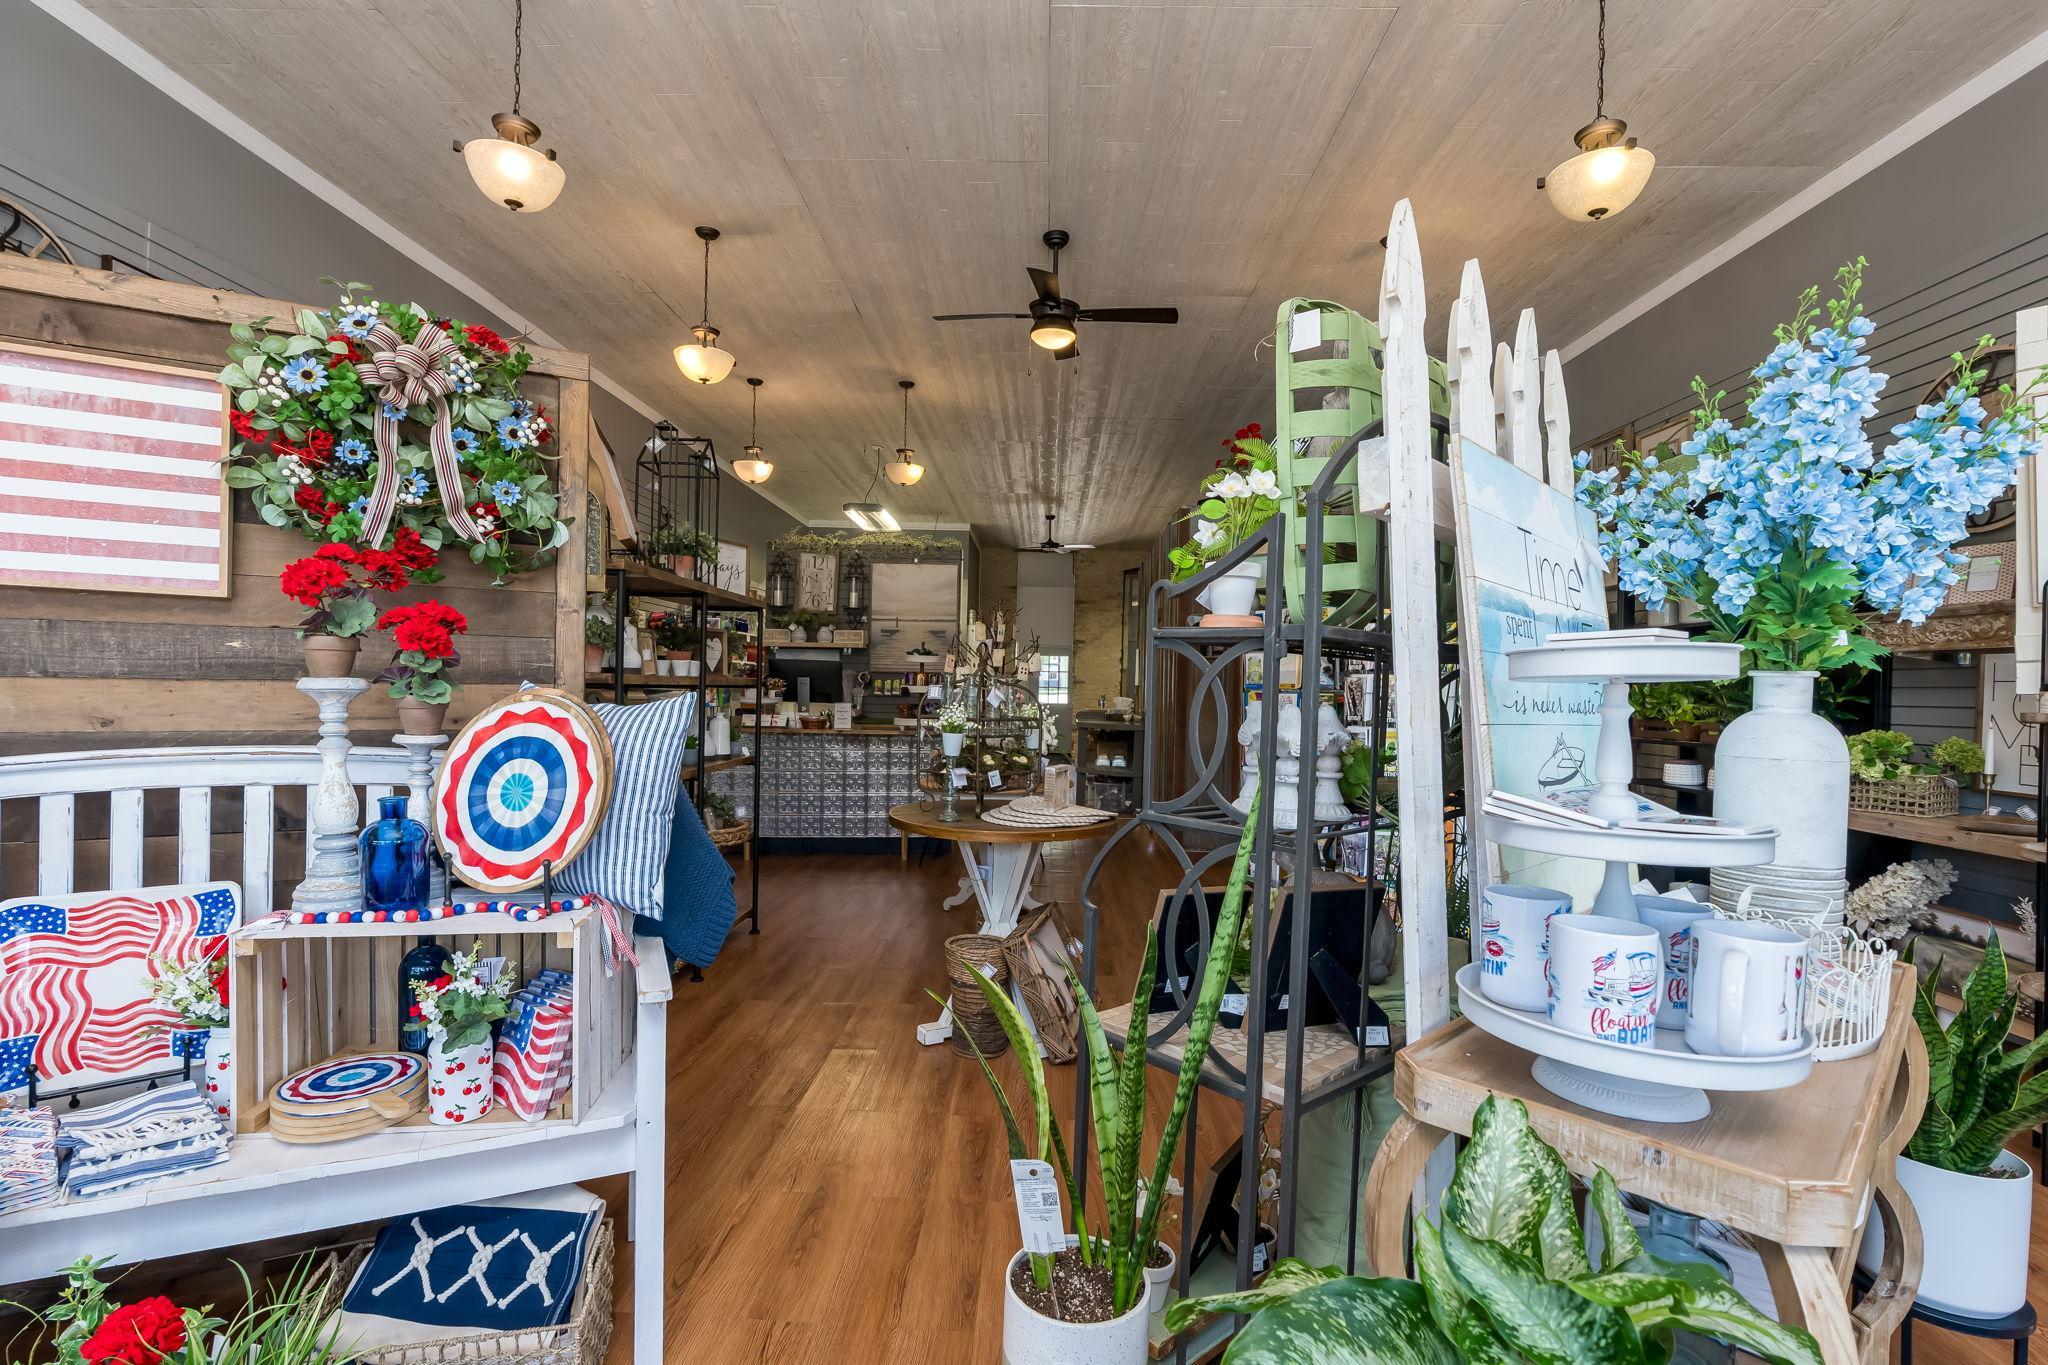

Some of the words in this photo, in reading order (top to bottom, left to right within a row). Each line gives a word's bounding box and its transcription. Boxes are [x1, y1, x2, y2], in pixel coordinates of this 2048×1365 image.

[812, 555, 825, 571] 12
[1517, 526, 1582, 611] Time
[1506, 614, 1534, 644] spent
[1503, 690, 1527, 715] is
[1533, 696, 1564, 714] never
[1617, 1023, 1654, 1045] BOAT
